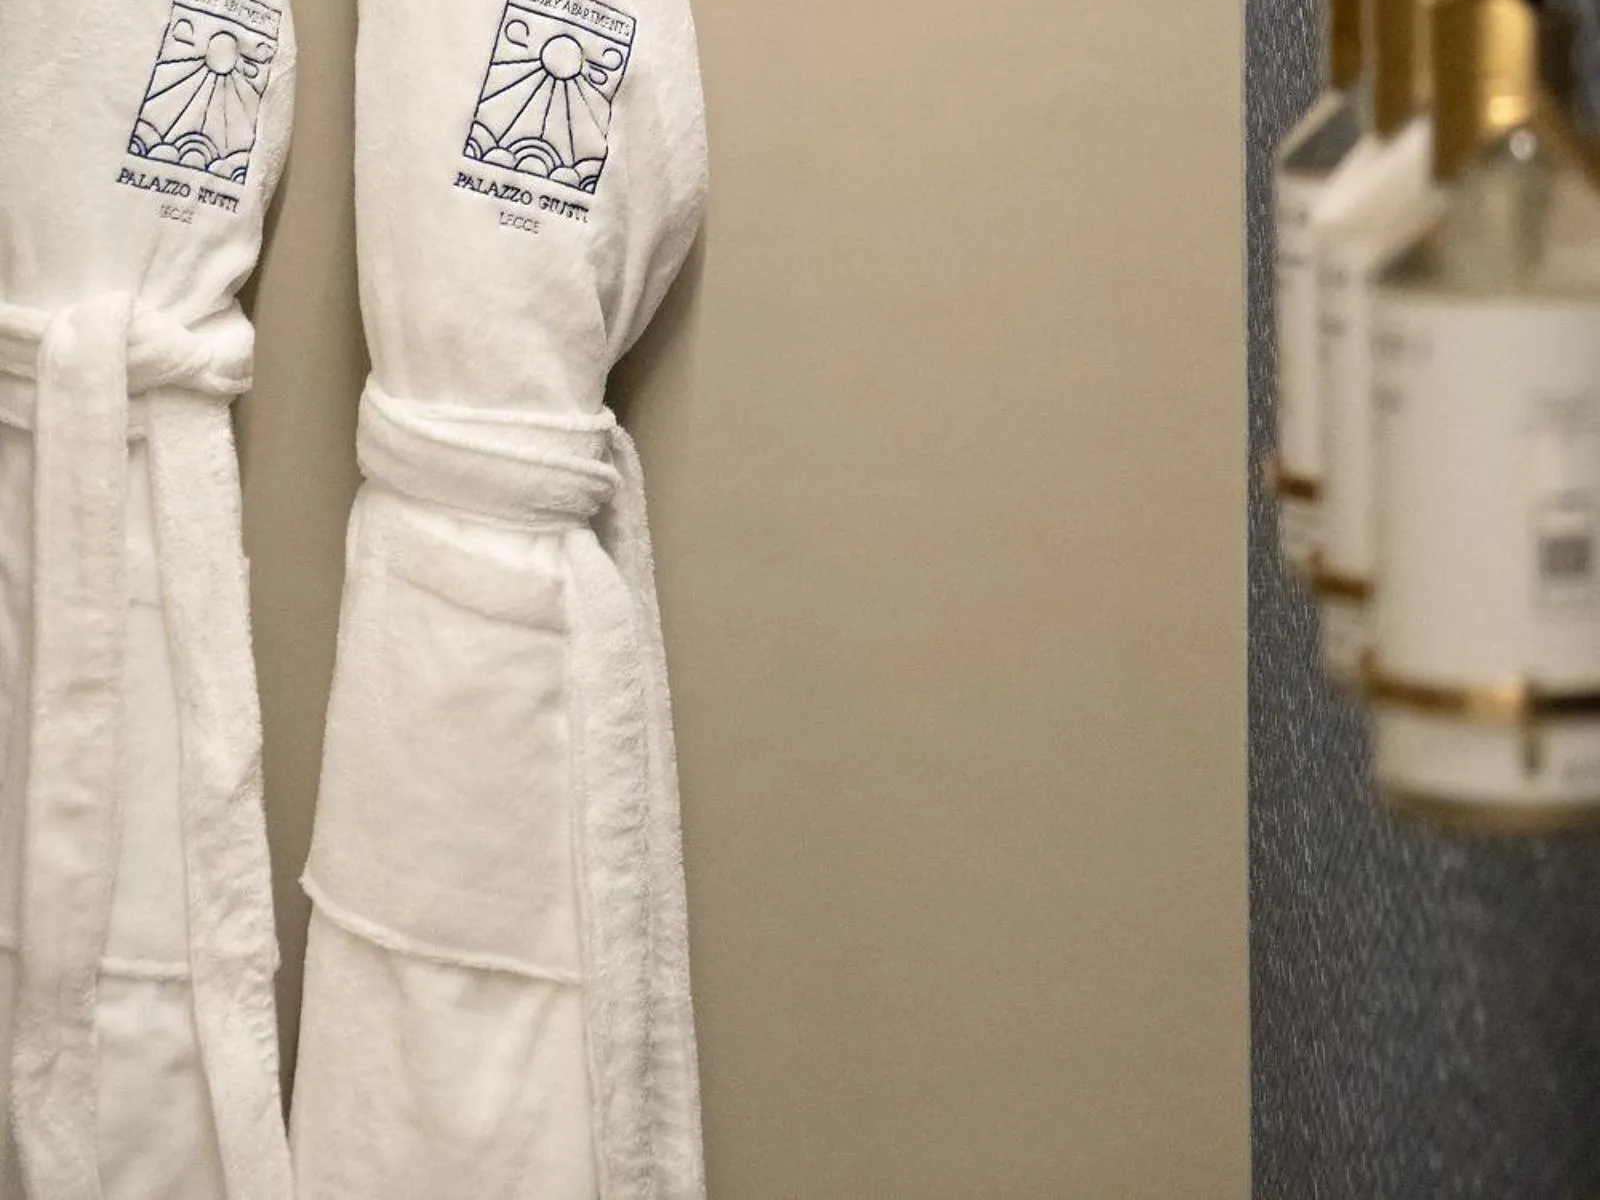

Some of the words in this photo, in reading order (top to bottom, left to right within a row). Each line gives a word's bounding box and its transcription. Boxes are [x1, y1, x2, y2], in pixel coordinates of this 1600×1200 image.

[115, 167, 192, 198] PALAZZO
[453, 171, 533, 206] PALAZZO
[499, 211, 541, 234] LECCE
